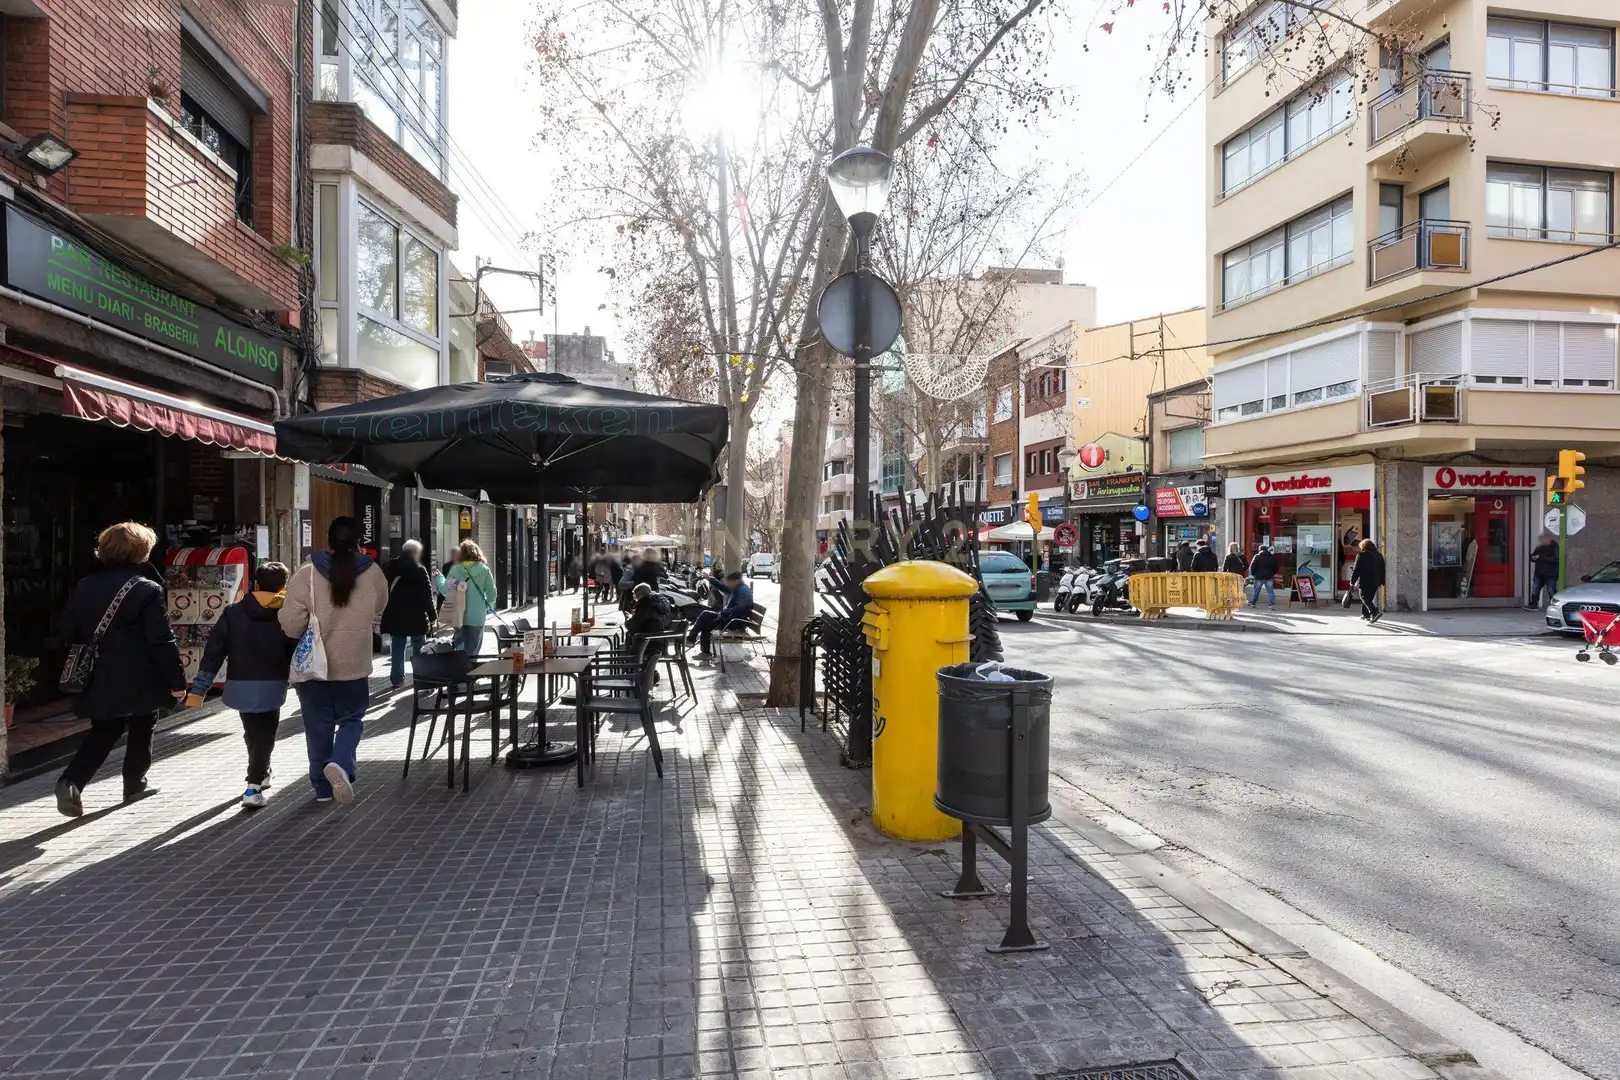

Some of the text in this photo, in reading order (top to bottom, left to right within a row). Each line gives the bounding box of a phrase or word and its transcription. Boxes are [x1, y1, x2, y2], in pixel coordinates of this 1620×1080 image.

[51, 235, 91, 271] BAR
[98, 292, 135, 321] DIARI
[144, 311, 199, 348] BRASERIA
[215, 326, 278, 372] ALONSO
[322, 398, 676, 446] Heineken
[1088, 480, 1100, 488] BAR
[1106, 475, 1145, 486] FRANKFURT
[1270, 474, 1332, 491] vodafone
[1458, 470, 1537, 488] vodafone
[363, 504, 372, 544] Vinalium
[971, 510, 1005, 526] CQUETTE
